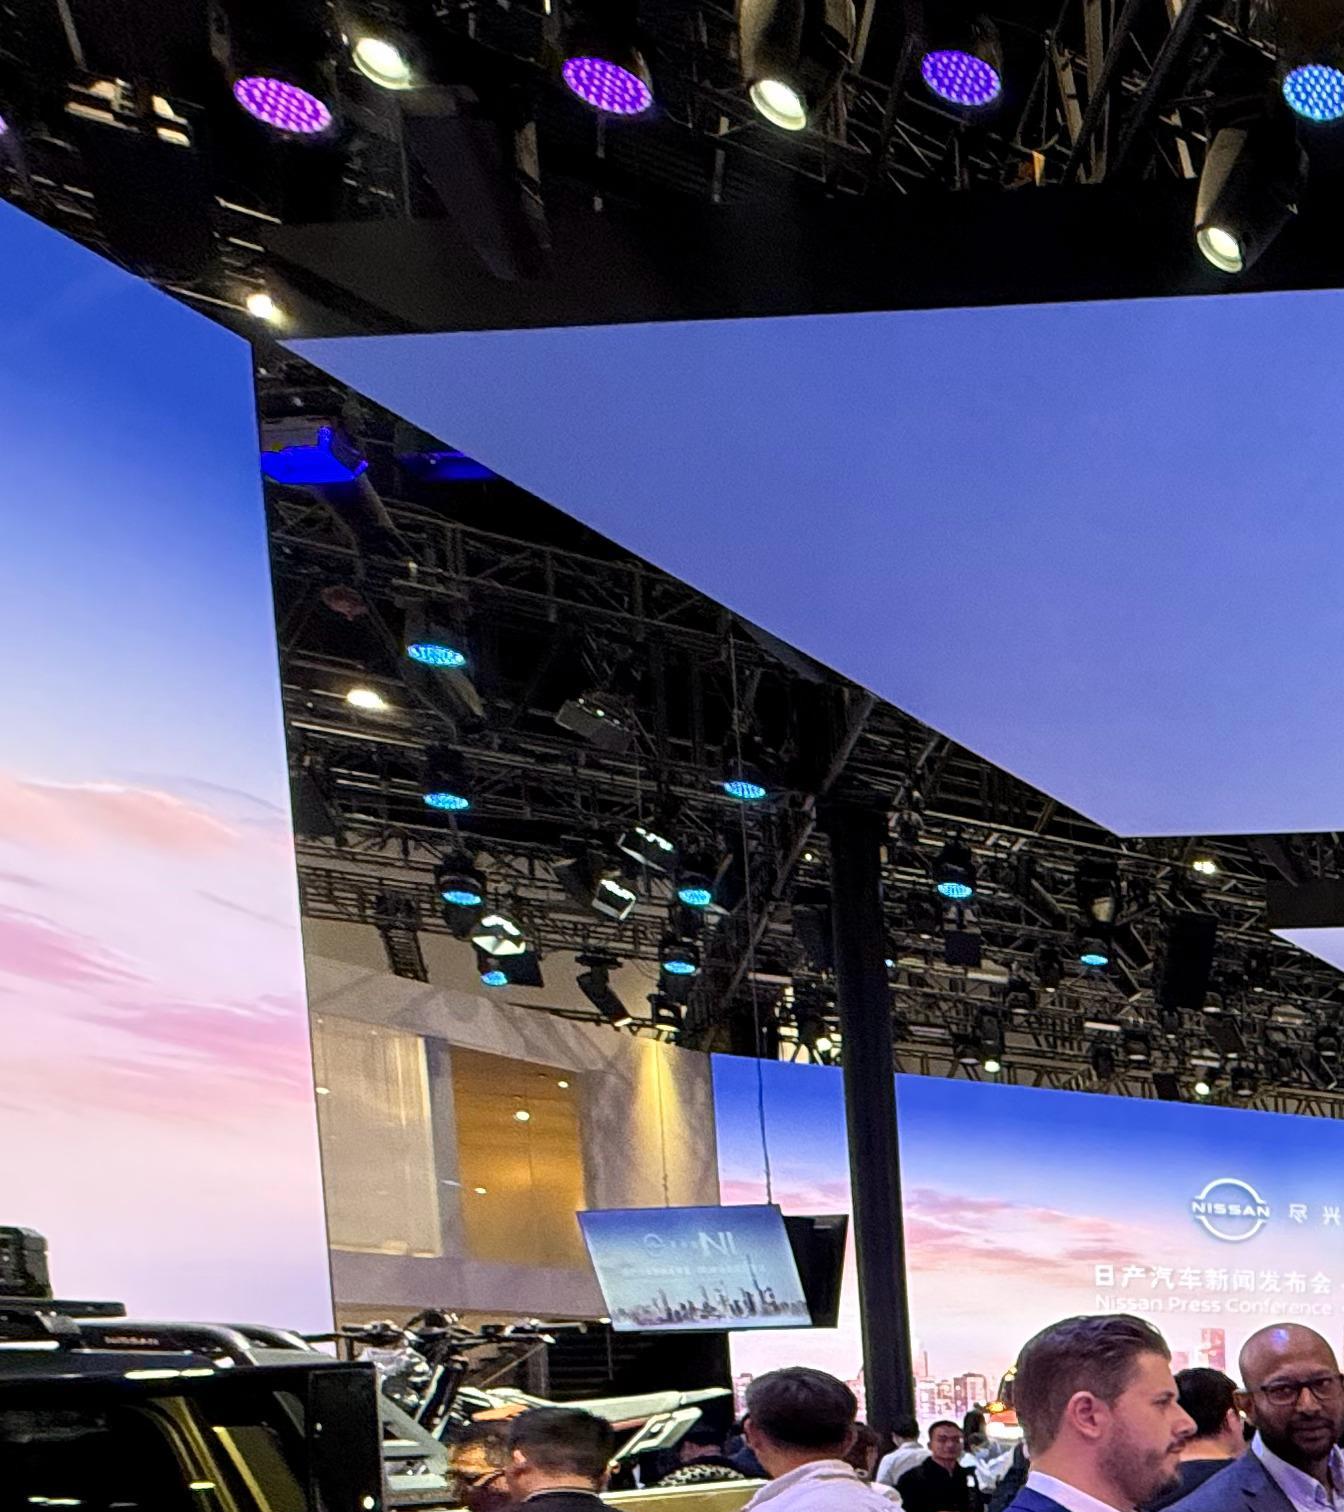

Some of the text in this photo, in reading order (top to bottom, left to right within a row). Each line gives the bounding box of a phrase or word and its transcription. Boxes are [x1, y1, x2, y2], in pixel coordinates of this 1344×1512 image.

[1191, 1200, 1270, 1218] NISSAN
[1094, 1264, 1332, 1294] 日产汽车新闻发布会
[1095, 1295, 1162, 1312] Nissan
[1169, 1299, 1221, 1313] Press
[1226, 1299, 1332, 1315] Conference
